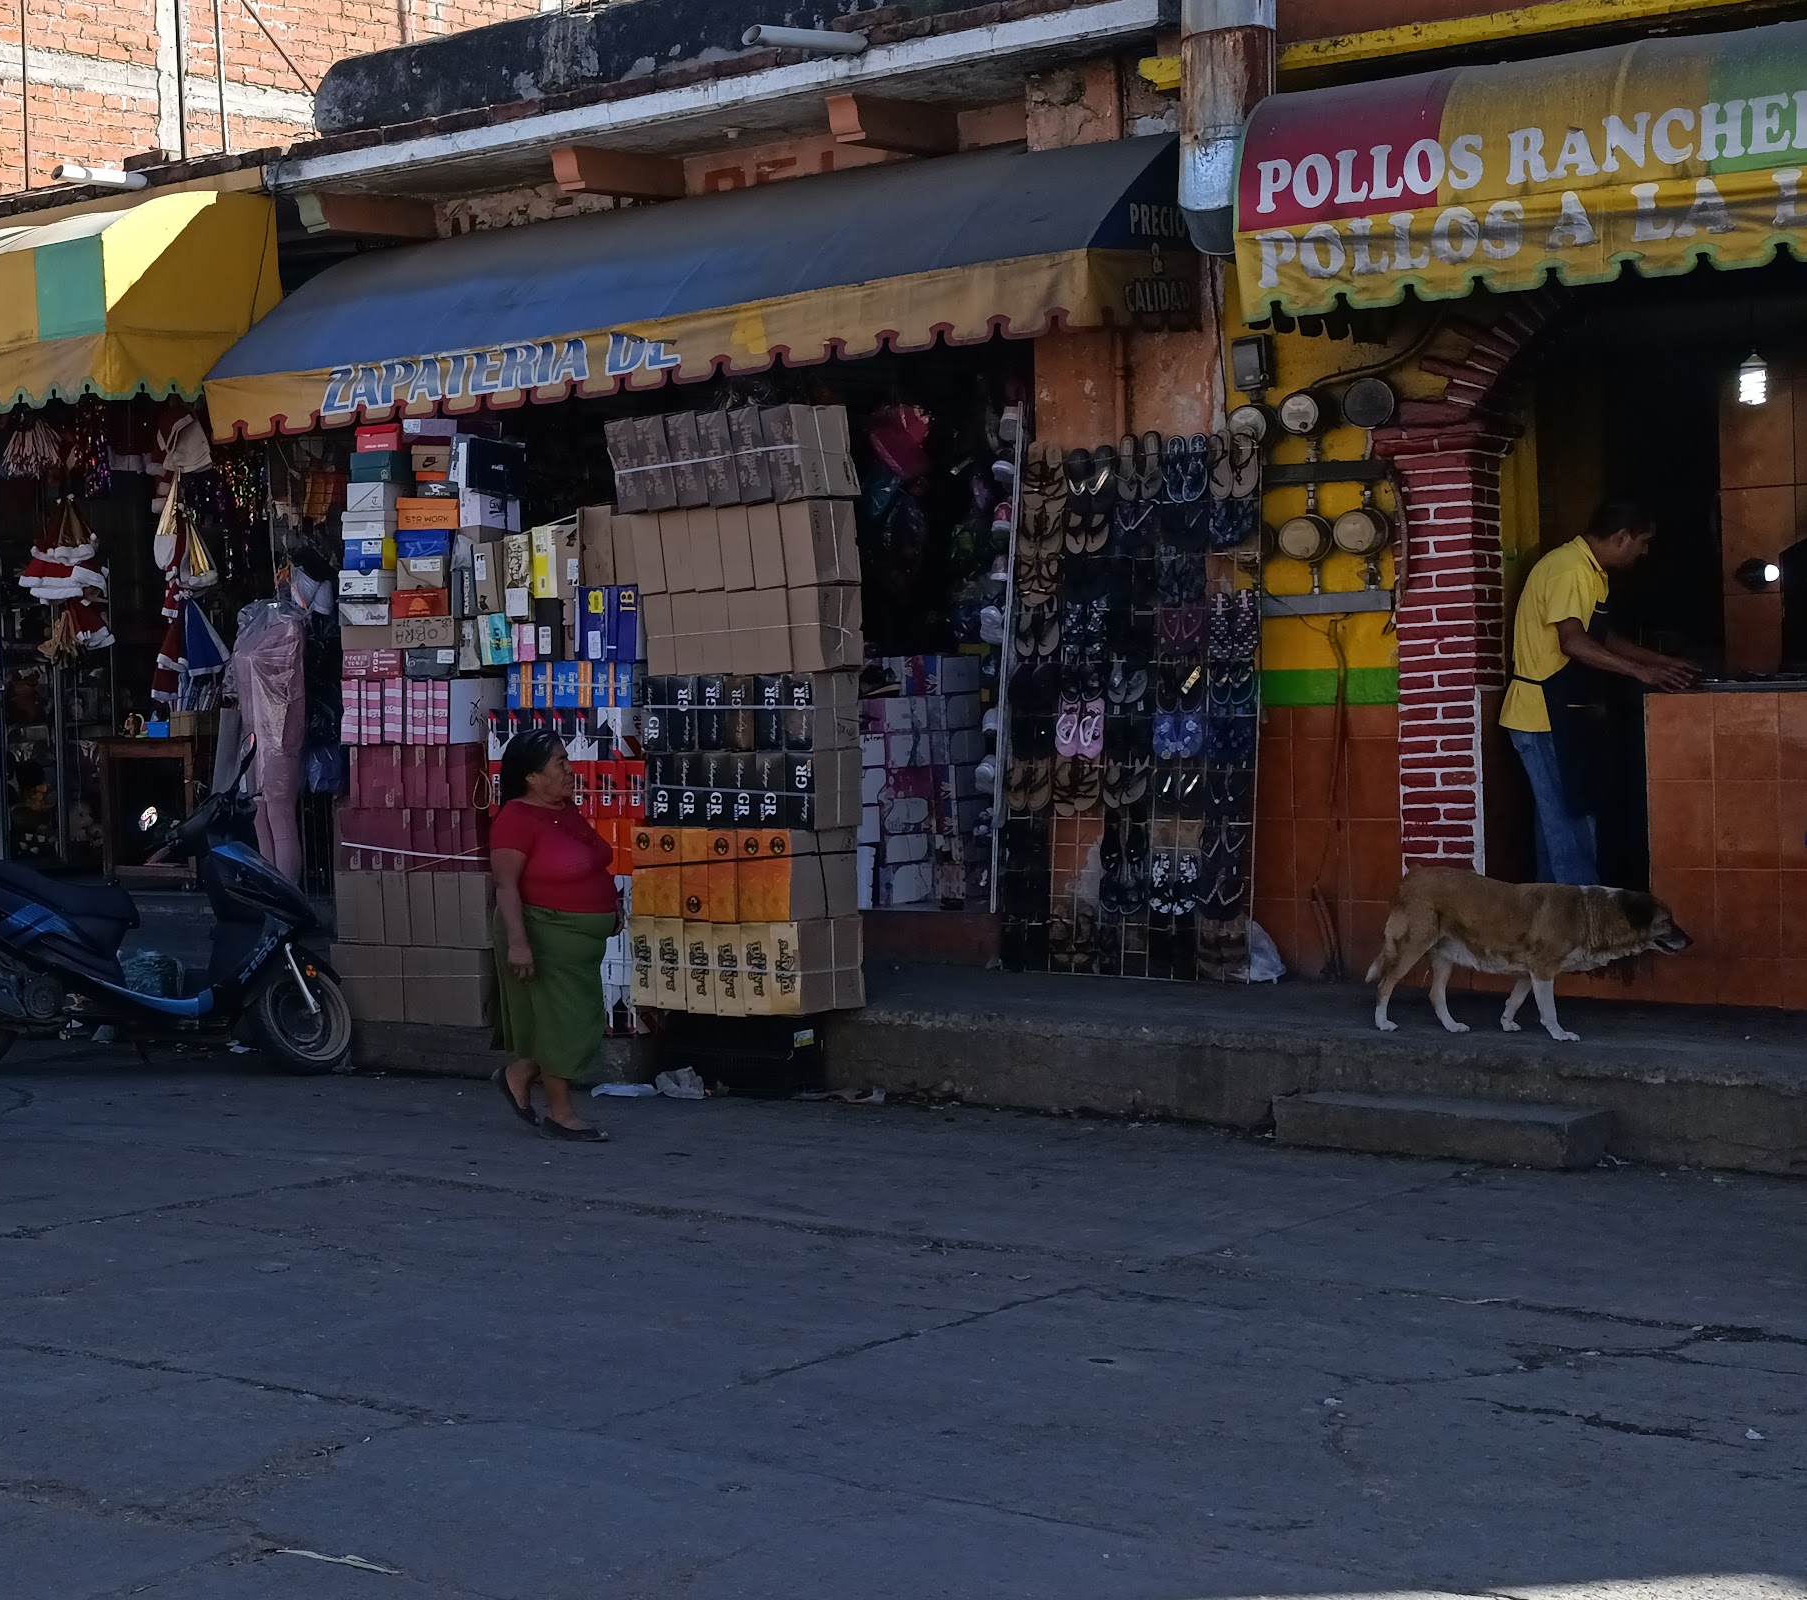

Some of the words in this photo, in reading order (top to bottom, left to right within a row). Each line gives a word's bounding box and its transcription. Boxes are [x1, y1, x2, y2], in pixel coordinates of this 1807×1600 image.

[1255, 134, 1484, 214] POLLOS
[1255, 200, 1525, 288] POLLOS
[1545, 190, 1599, 251] A
[1631, 176, 1736, 242] LA
[1151, 242, 1164, 274] &
[320, 338, 590, 416] ZAPATERIA
[424, 515, 449, 523] WORK
[395, 626, 448, 644] COBRA
[677, 687, 689, 711] GR
[705, 686, 716, 708] GR
[731, 688, 742, 708] GR
[765, 686, 776, 710] GR
[794, 686, 806, 711] GR
[648, 716, 660, 739] GR
[795, 764, 808, 789] GR
[657, 790, 669, 814] GR
[683, 791, 695, 815] GR
[710, 791, 722, 815] GR
[738, 792, 750, 816] GR
[764, 792, 777, 816] GR
[238, 936, 278, 984] X150
